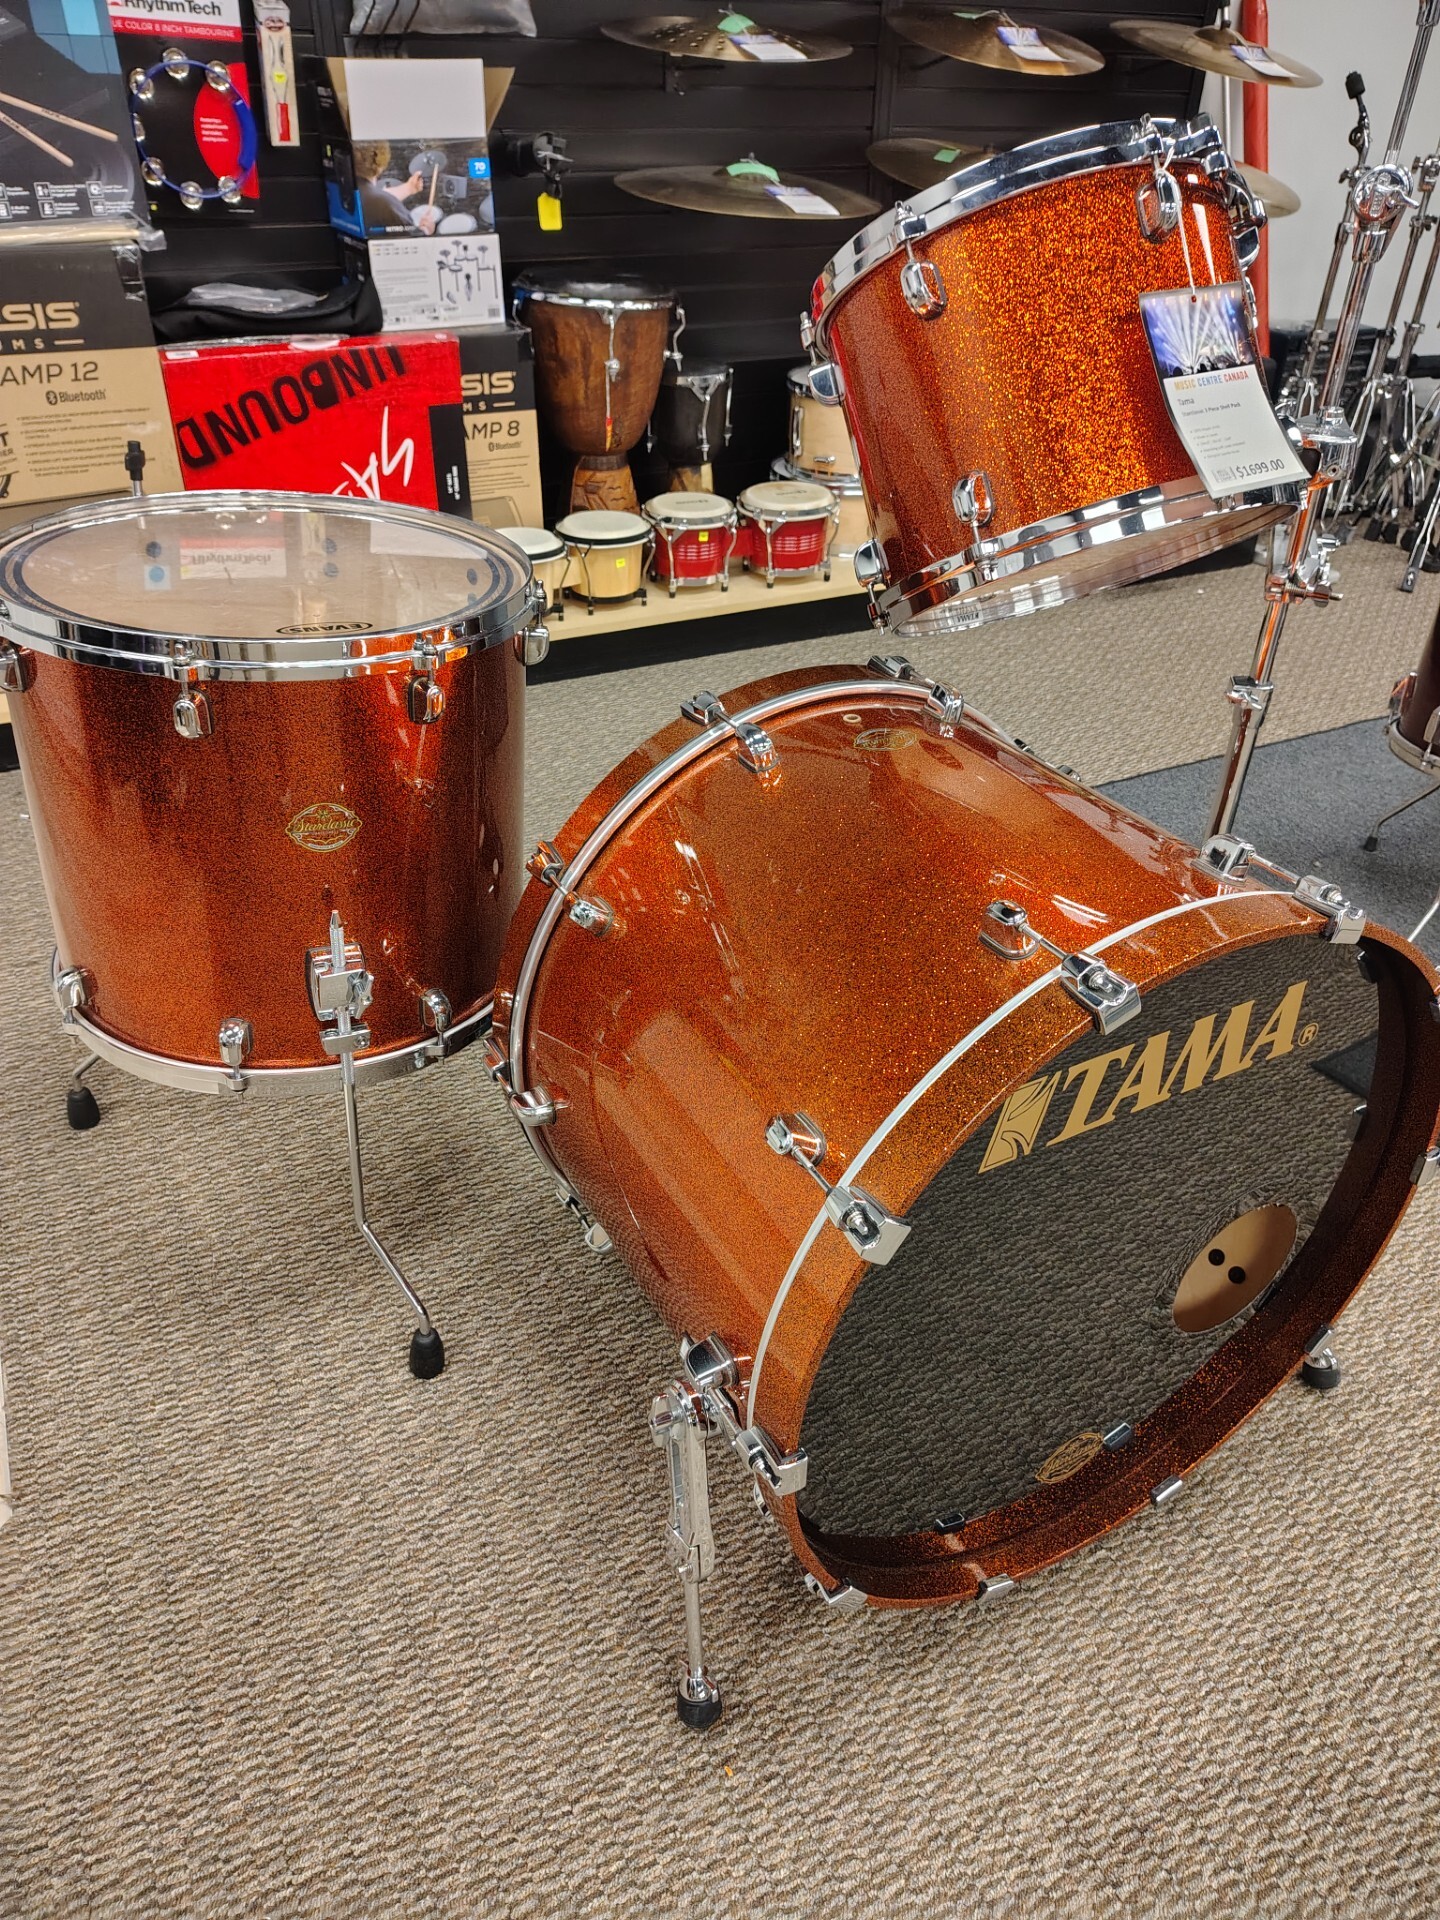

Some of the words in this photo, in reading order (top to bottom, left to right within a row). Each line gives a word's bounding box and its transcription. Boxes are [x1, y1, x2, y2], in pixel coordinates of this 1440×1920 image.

[125, 21, 153, 31] COLOR
[162, 23, 182, 33] INCH
[183, 26, 235, 38] TAMBOURINE
[0, 363, 62, 386] AMP
[70, 361, 99, 382] 12
[1174, 379, 1196, 391] MUSIC
[1197, 375, 1223, 387] CENTRE
[1223, 370, 1249, 382] CANADA
[58, 389, 105, 403] Bluetooth
[1177, 397, 1195, 406] Tama
[464, 421, 502, 440] MP
[507, 420, 520, 437] 8
[1235, 458, 1285, 479] $1699.00
[289, 623, 363, 633] EVANS
[1046, 980, 1308, 1147] TAMA
